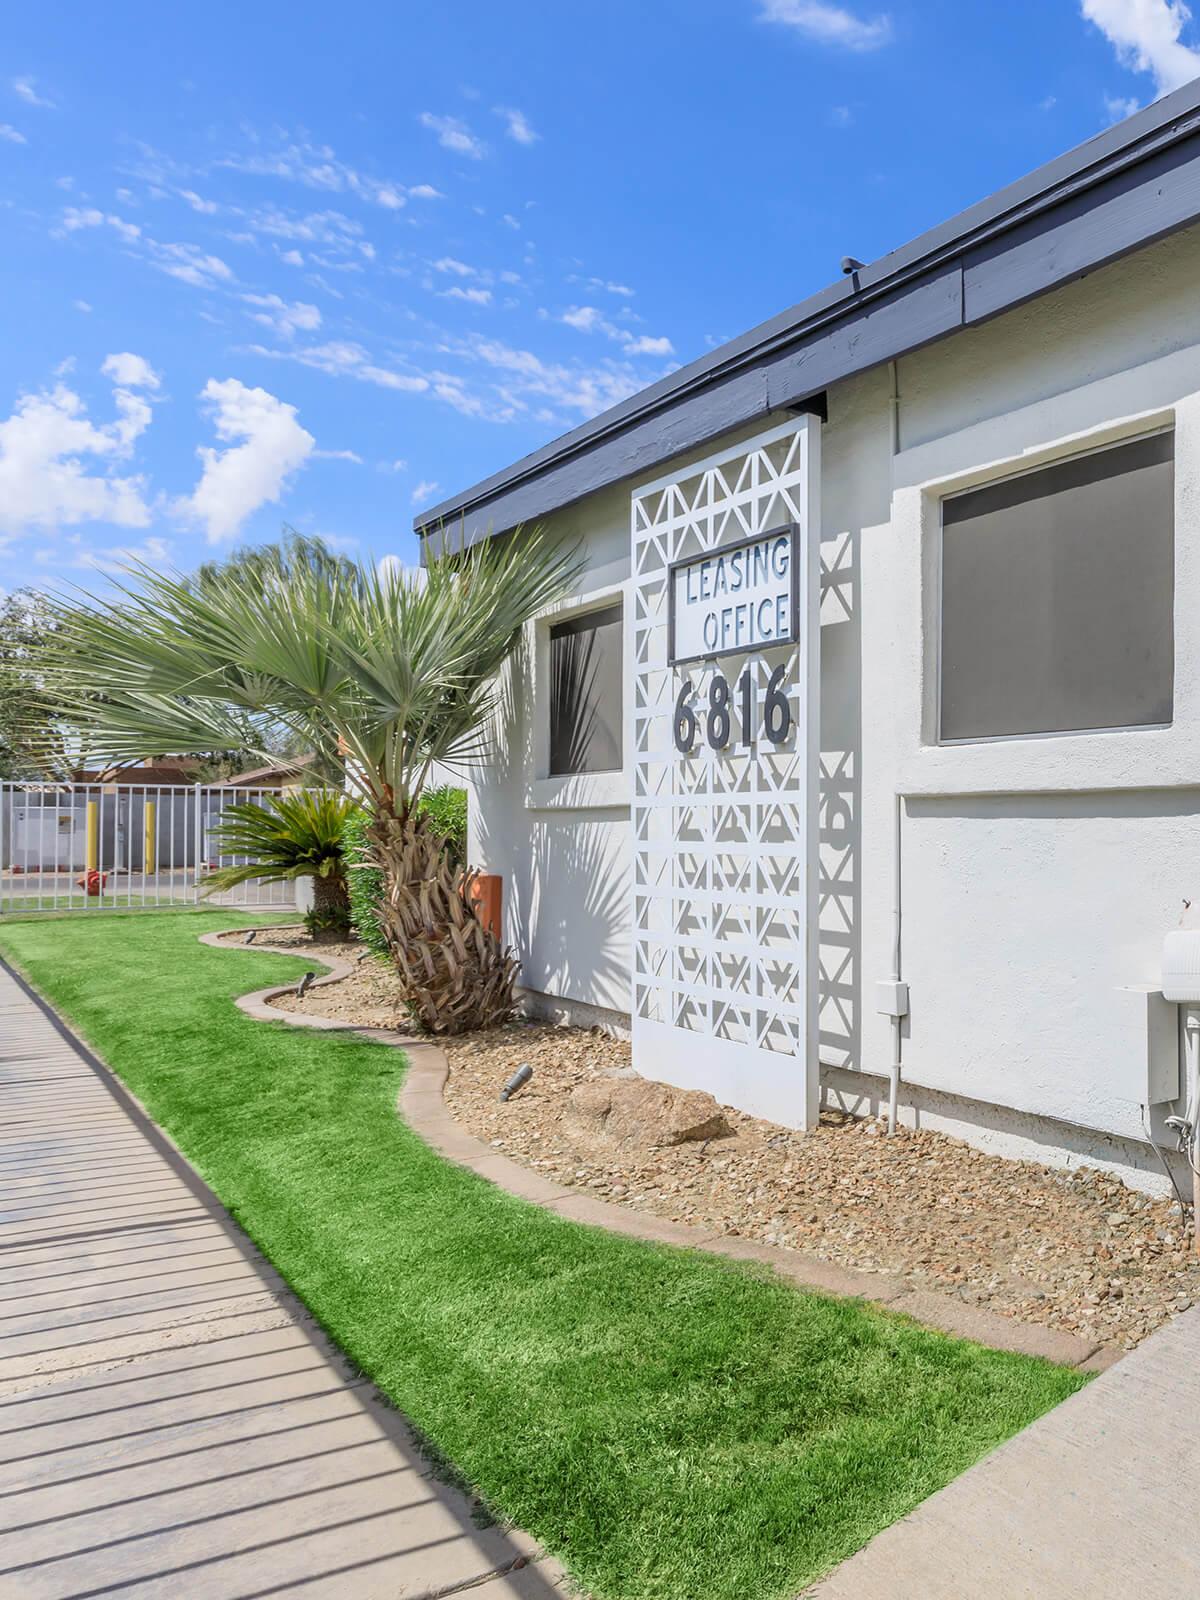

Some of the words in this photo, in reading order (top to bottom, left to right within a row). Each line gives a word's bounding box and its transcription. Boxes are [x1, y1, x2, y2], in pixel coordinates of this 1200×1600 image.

[686, 537, 790, 605] LEASING
[703, 593, 790, 651] OFFICE
[674, 664, 790, 753] 6816
